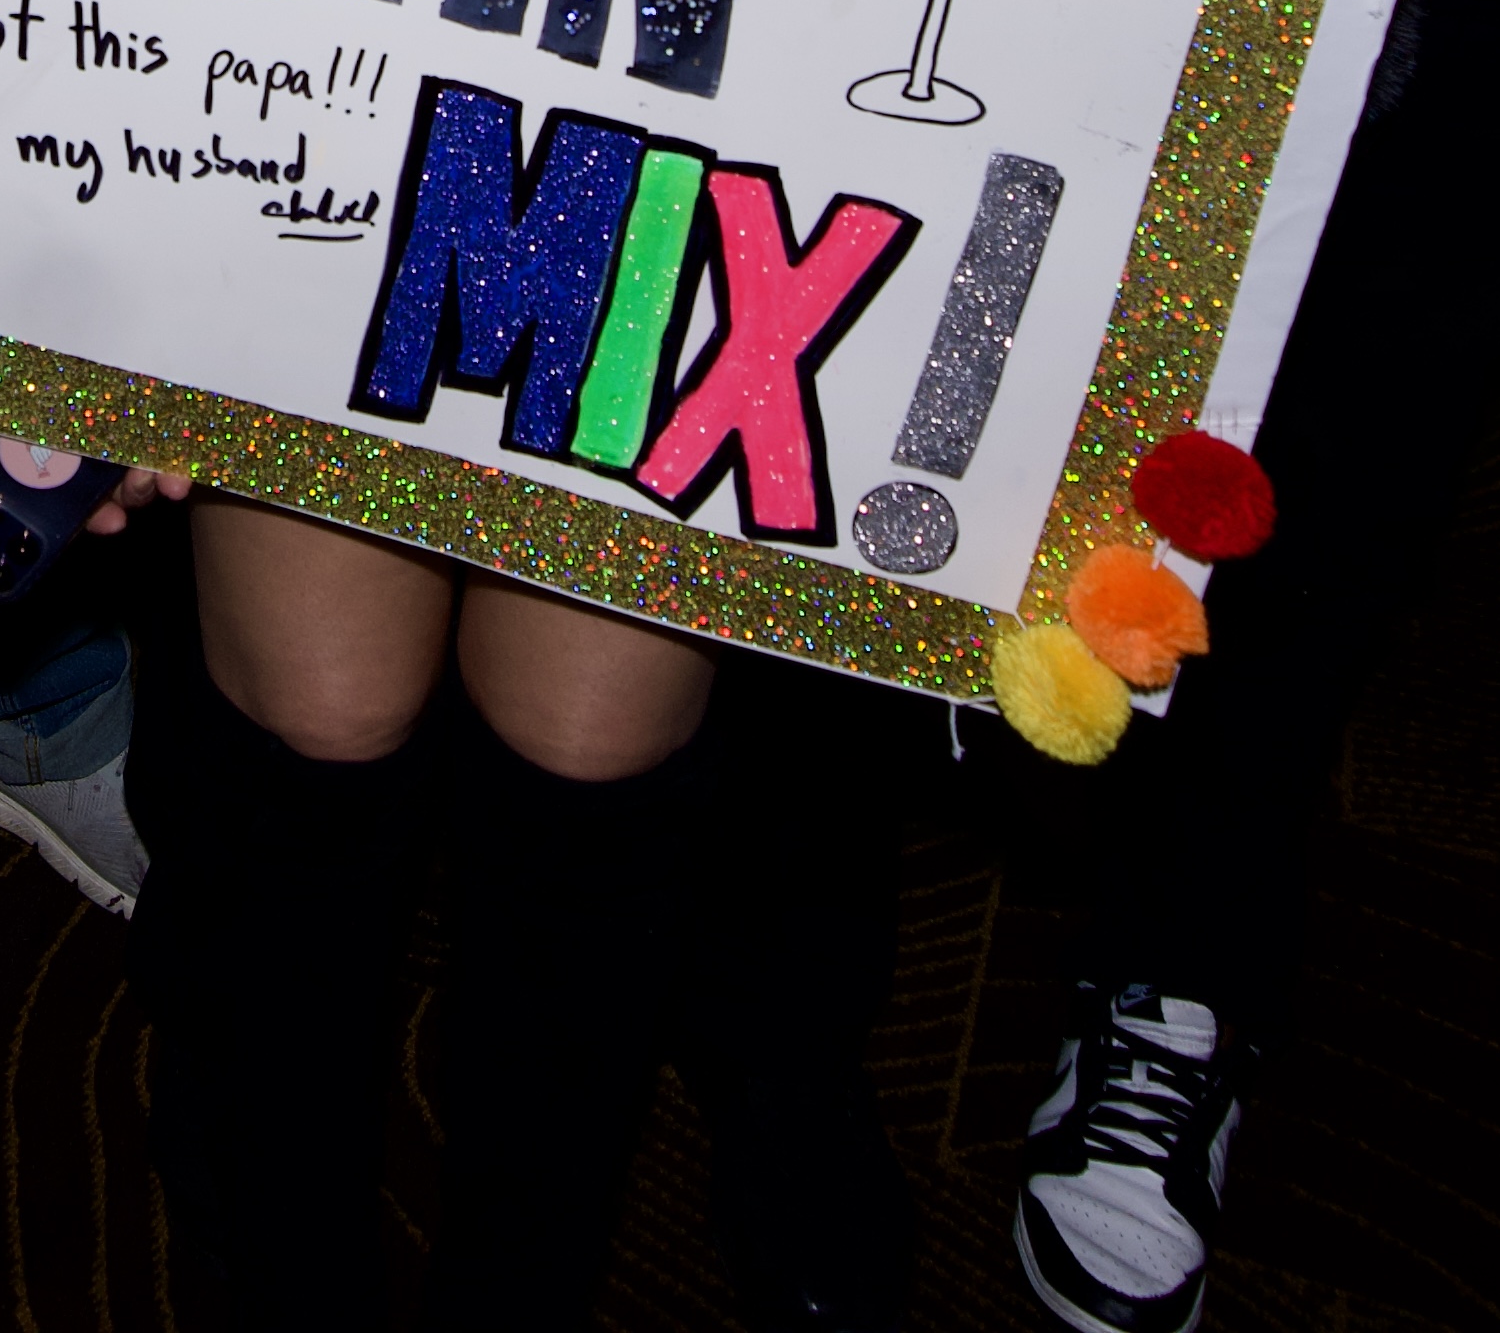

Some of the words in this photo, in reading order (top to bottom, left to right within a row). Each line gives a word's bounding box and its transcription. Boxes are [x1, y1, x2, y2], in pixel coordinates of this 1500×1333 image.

[69, 0, 168, 75] this
[204, 46, 387, 121] papa!!!
[16, 133, 104, 203] my
[124, 129, 307, 183] husband
